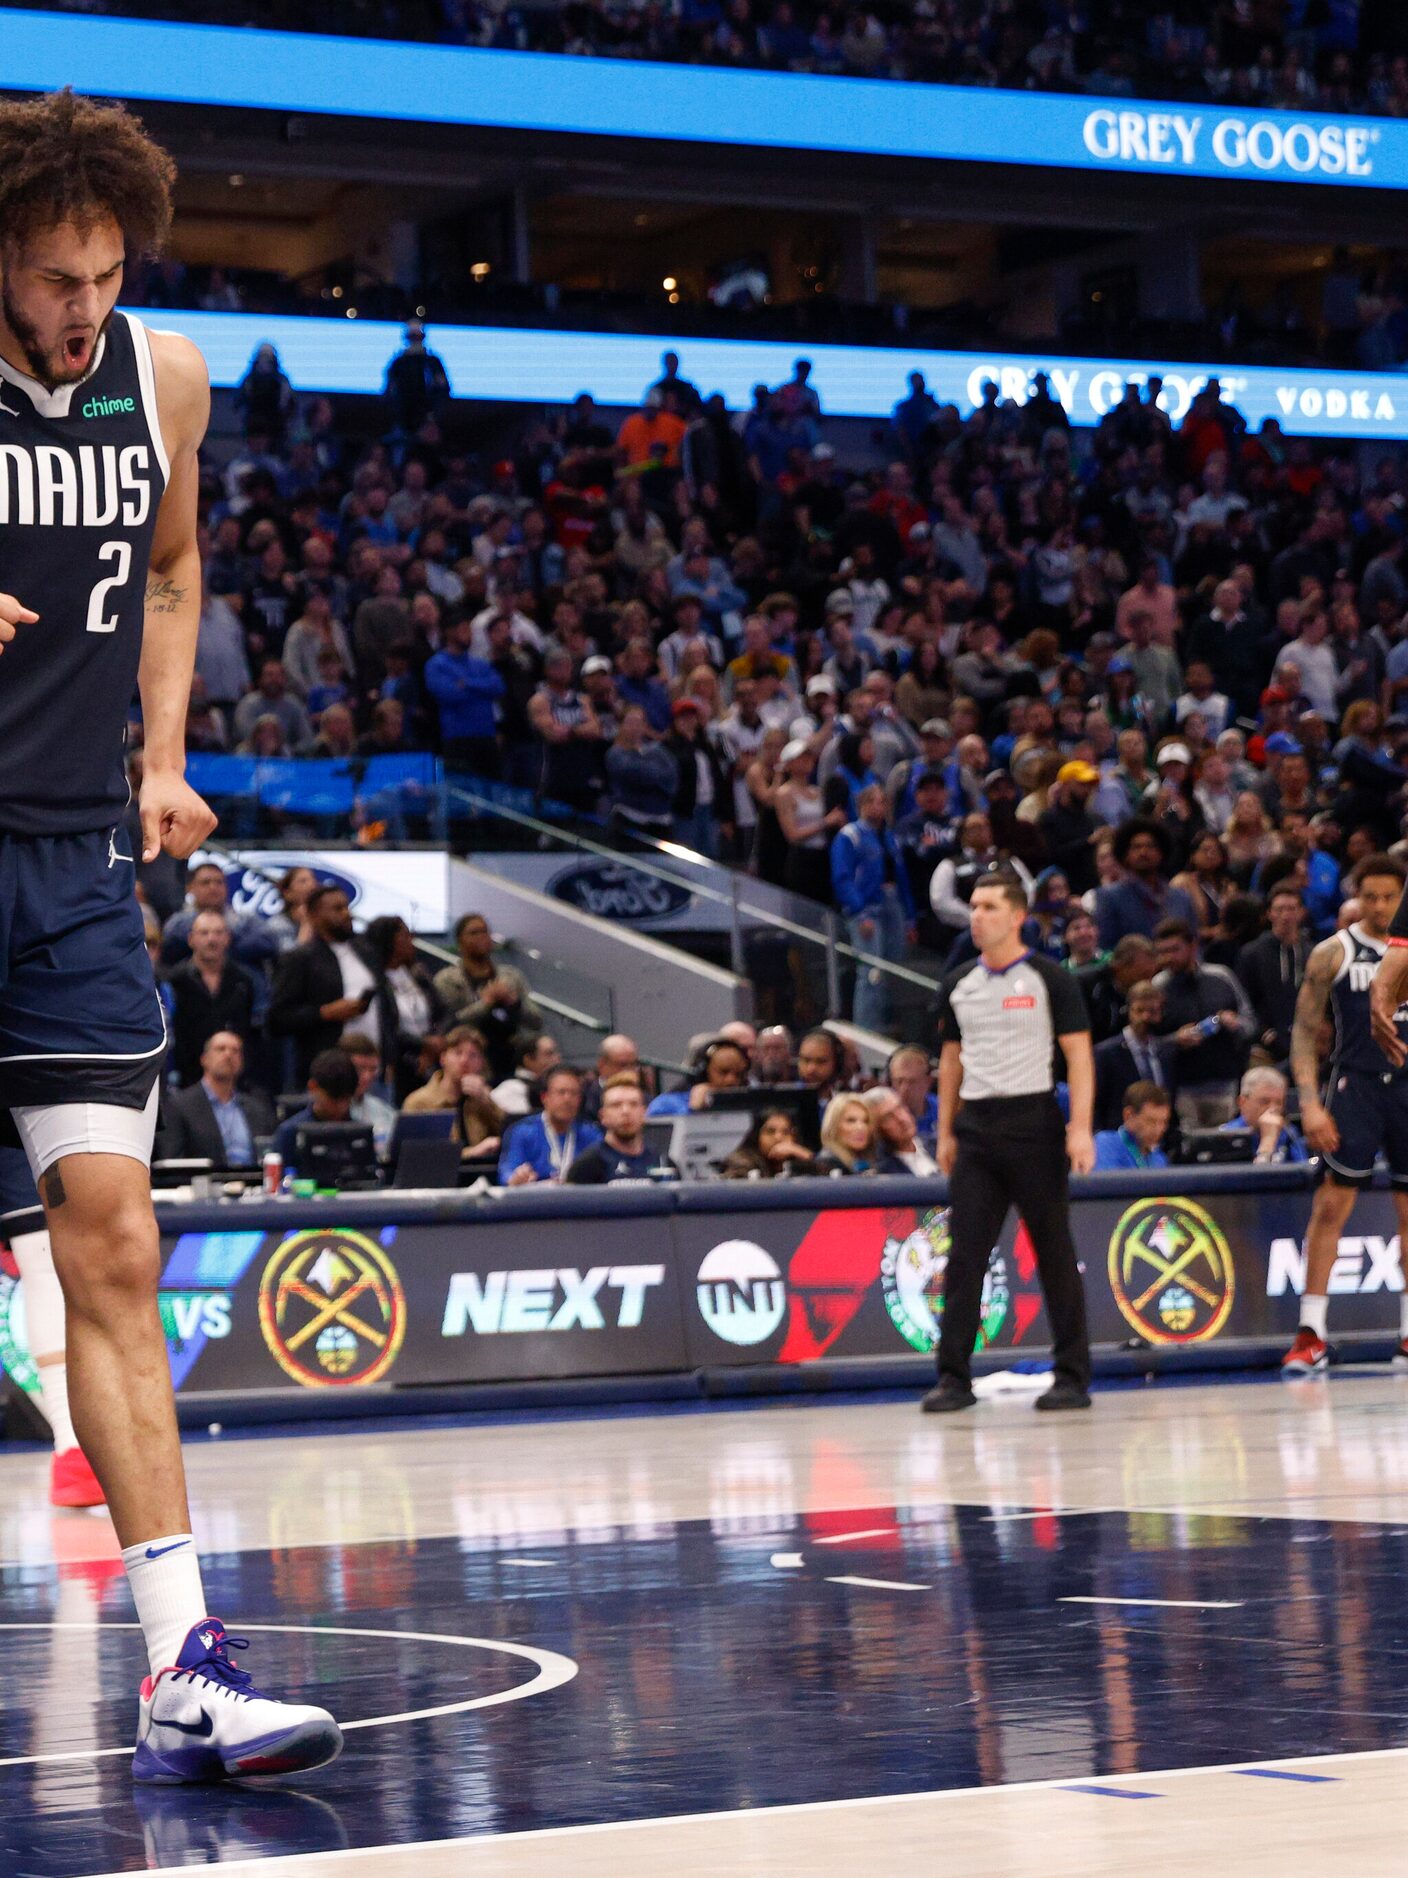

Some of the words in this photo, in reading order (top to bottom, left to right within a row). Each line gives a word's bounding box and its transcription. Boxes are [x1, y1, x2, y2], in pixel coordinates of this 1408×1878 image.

[1082, 109, 1202, 164] GREY
[1212, 119, 1372, 176] GOOSE
[82, 395, 135, 418] chime
[1276, 387, 1396, 421] VODKA
[86, 541, 132, 632] 2
[1266, 1234, 1407, 1296] NEX
[172, 1293, 233, 1339] VS
[441, 1264, 666, 1337] NEXT
